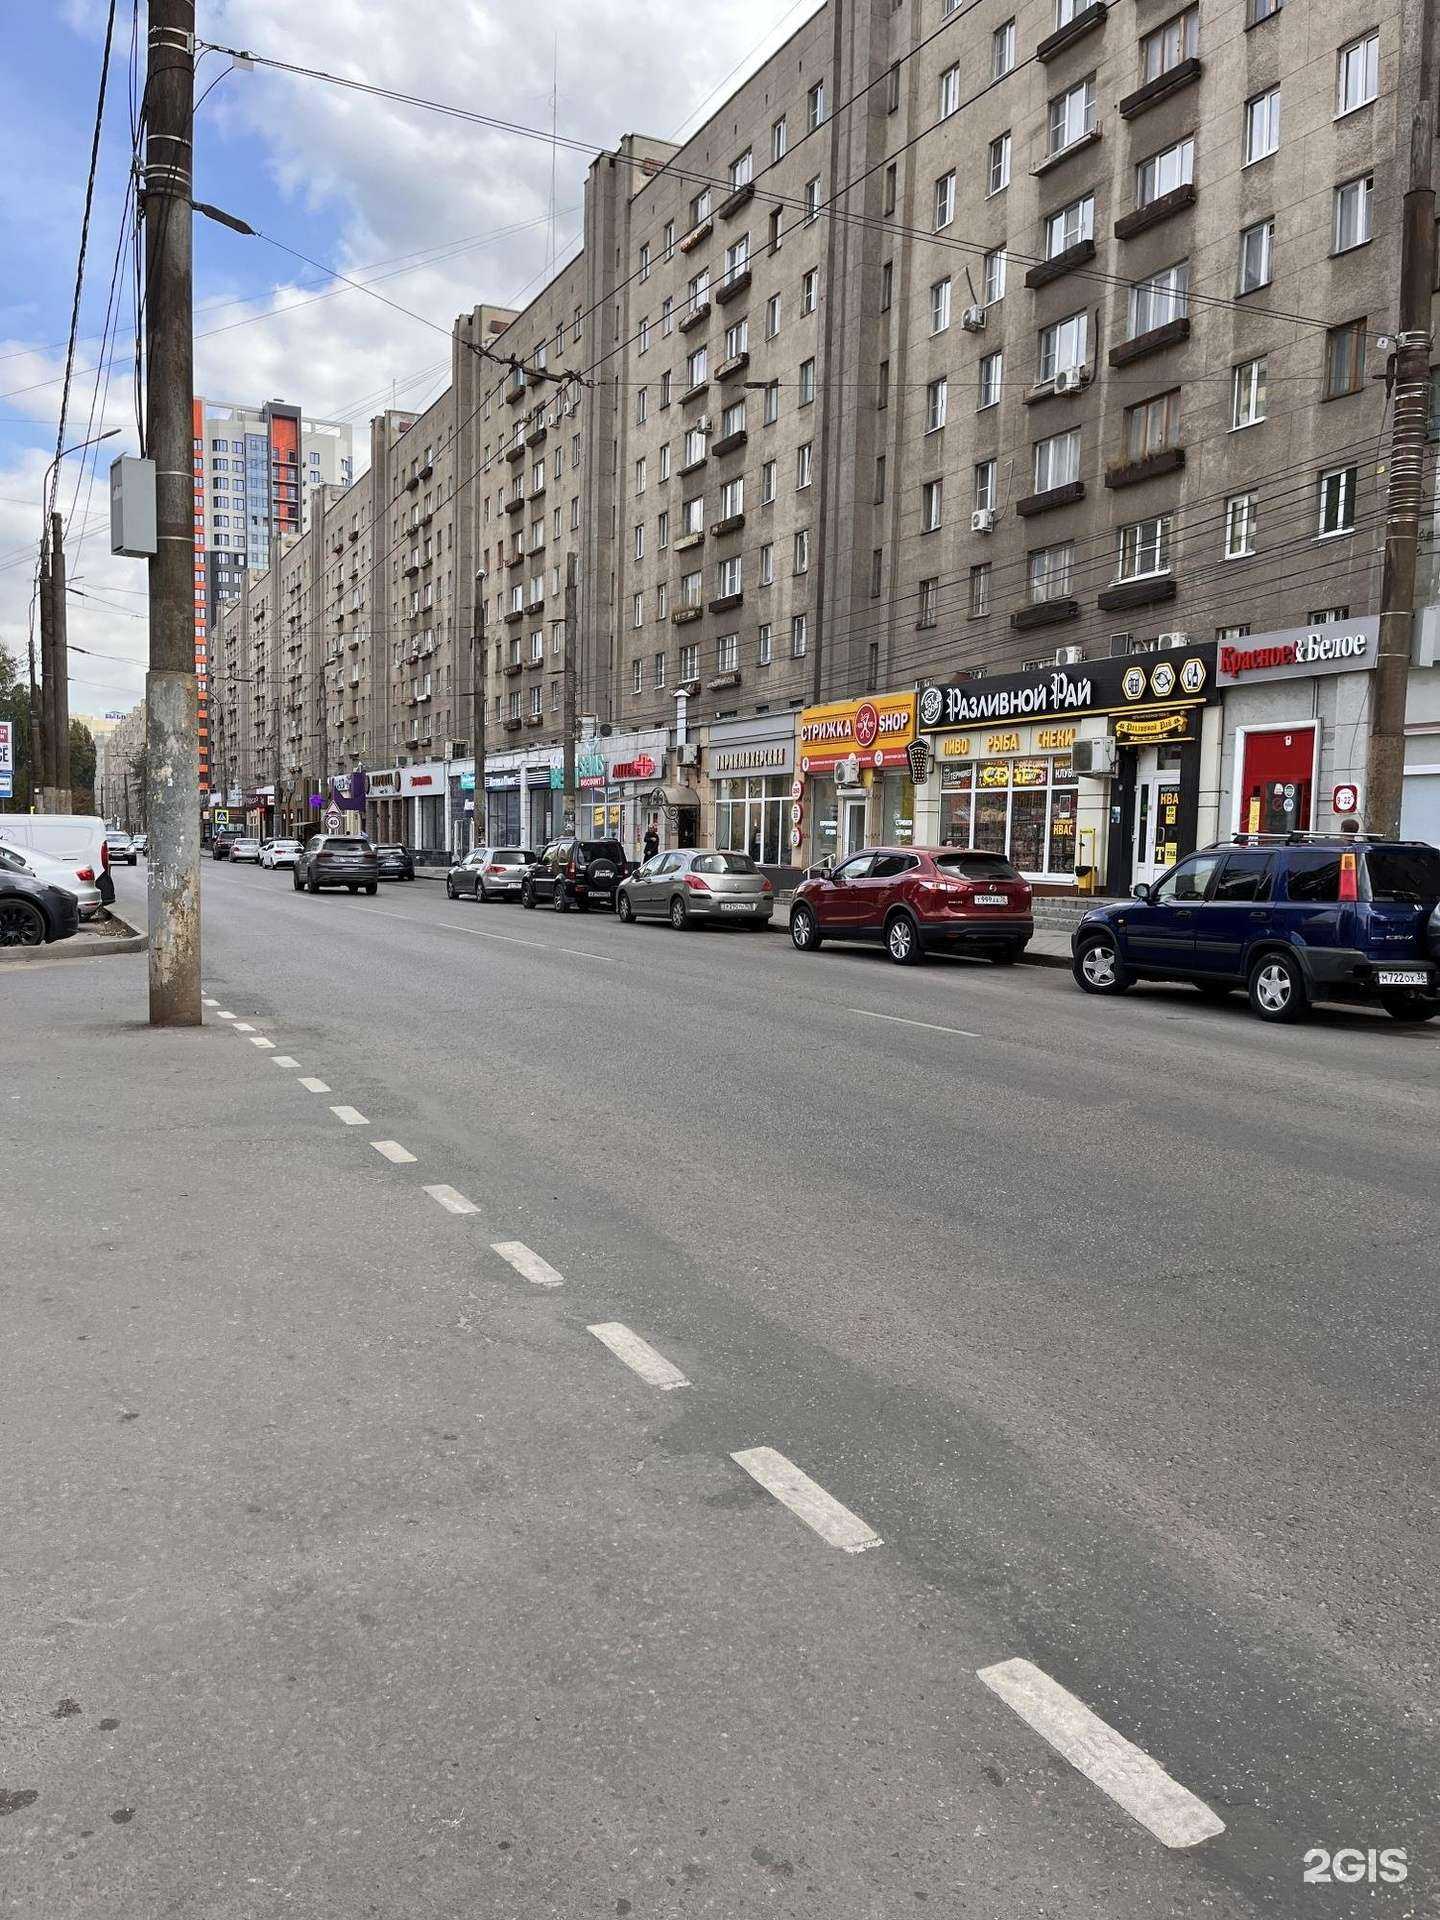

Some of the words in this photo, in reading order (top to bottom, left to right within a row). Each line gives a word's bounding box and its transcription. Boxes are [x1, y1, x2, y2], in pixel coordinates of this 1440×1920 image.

[801, 719, 852, 740] СТРИЖКА
[879, 712, 909, 732] SHOP
[944, 737, 970, 756] ПИВО
[987, 733, 1019, 753] РЫБА
[1038, 729, 1076, 748] СНЕКИ
